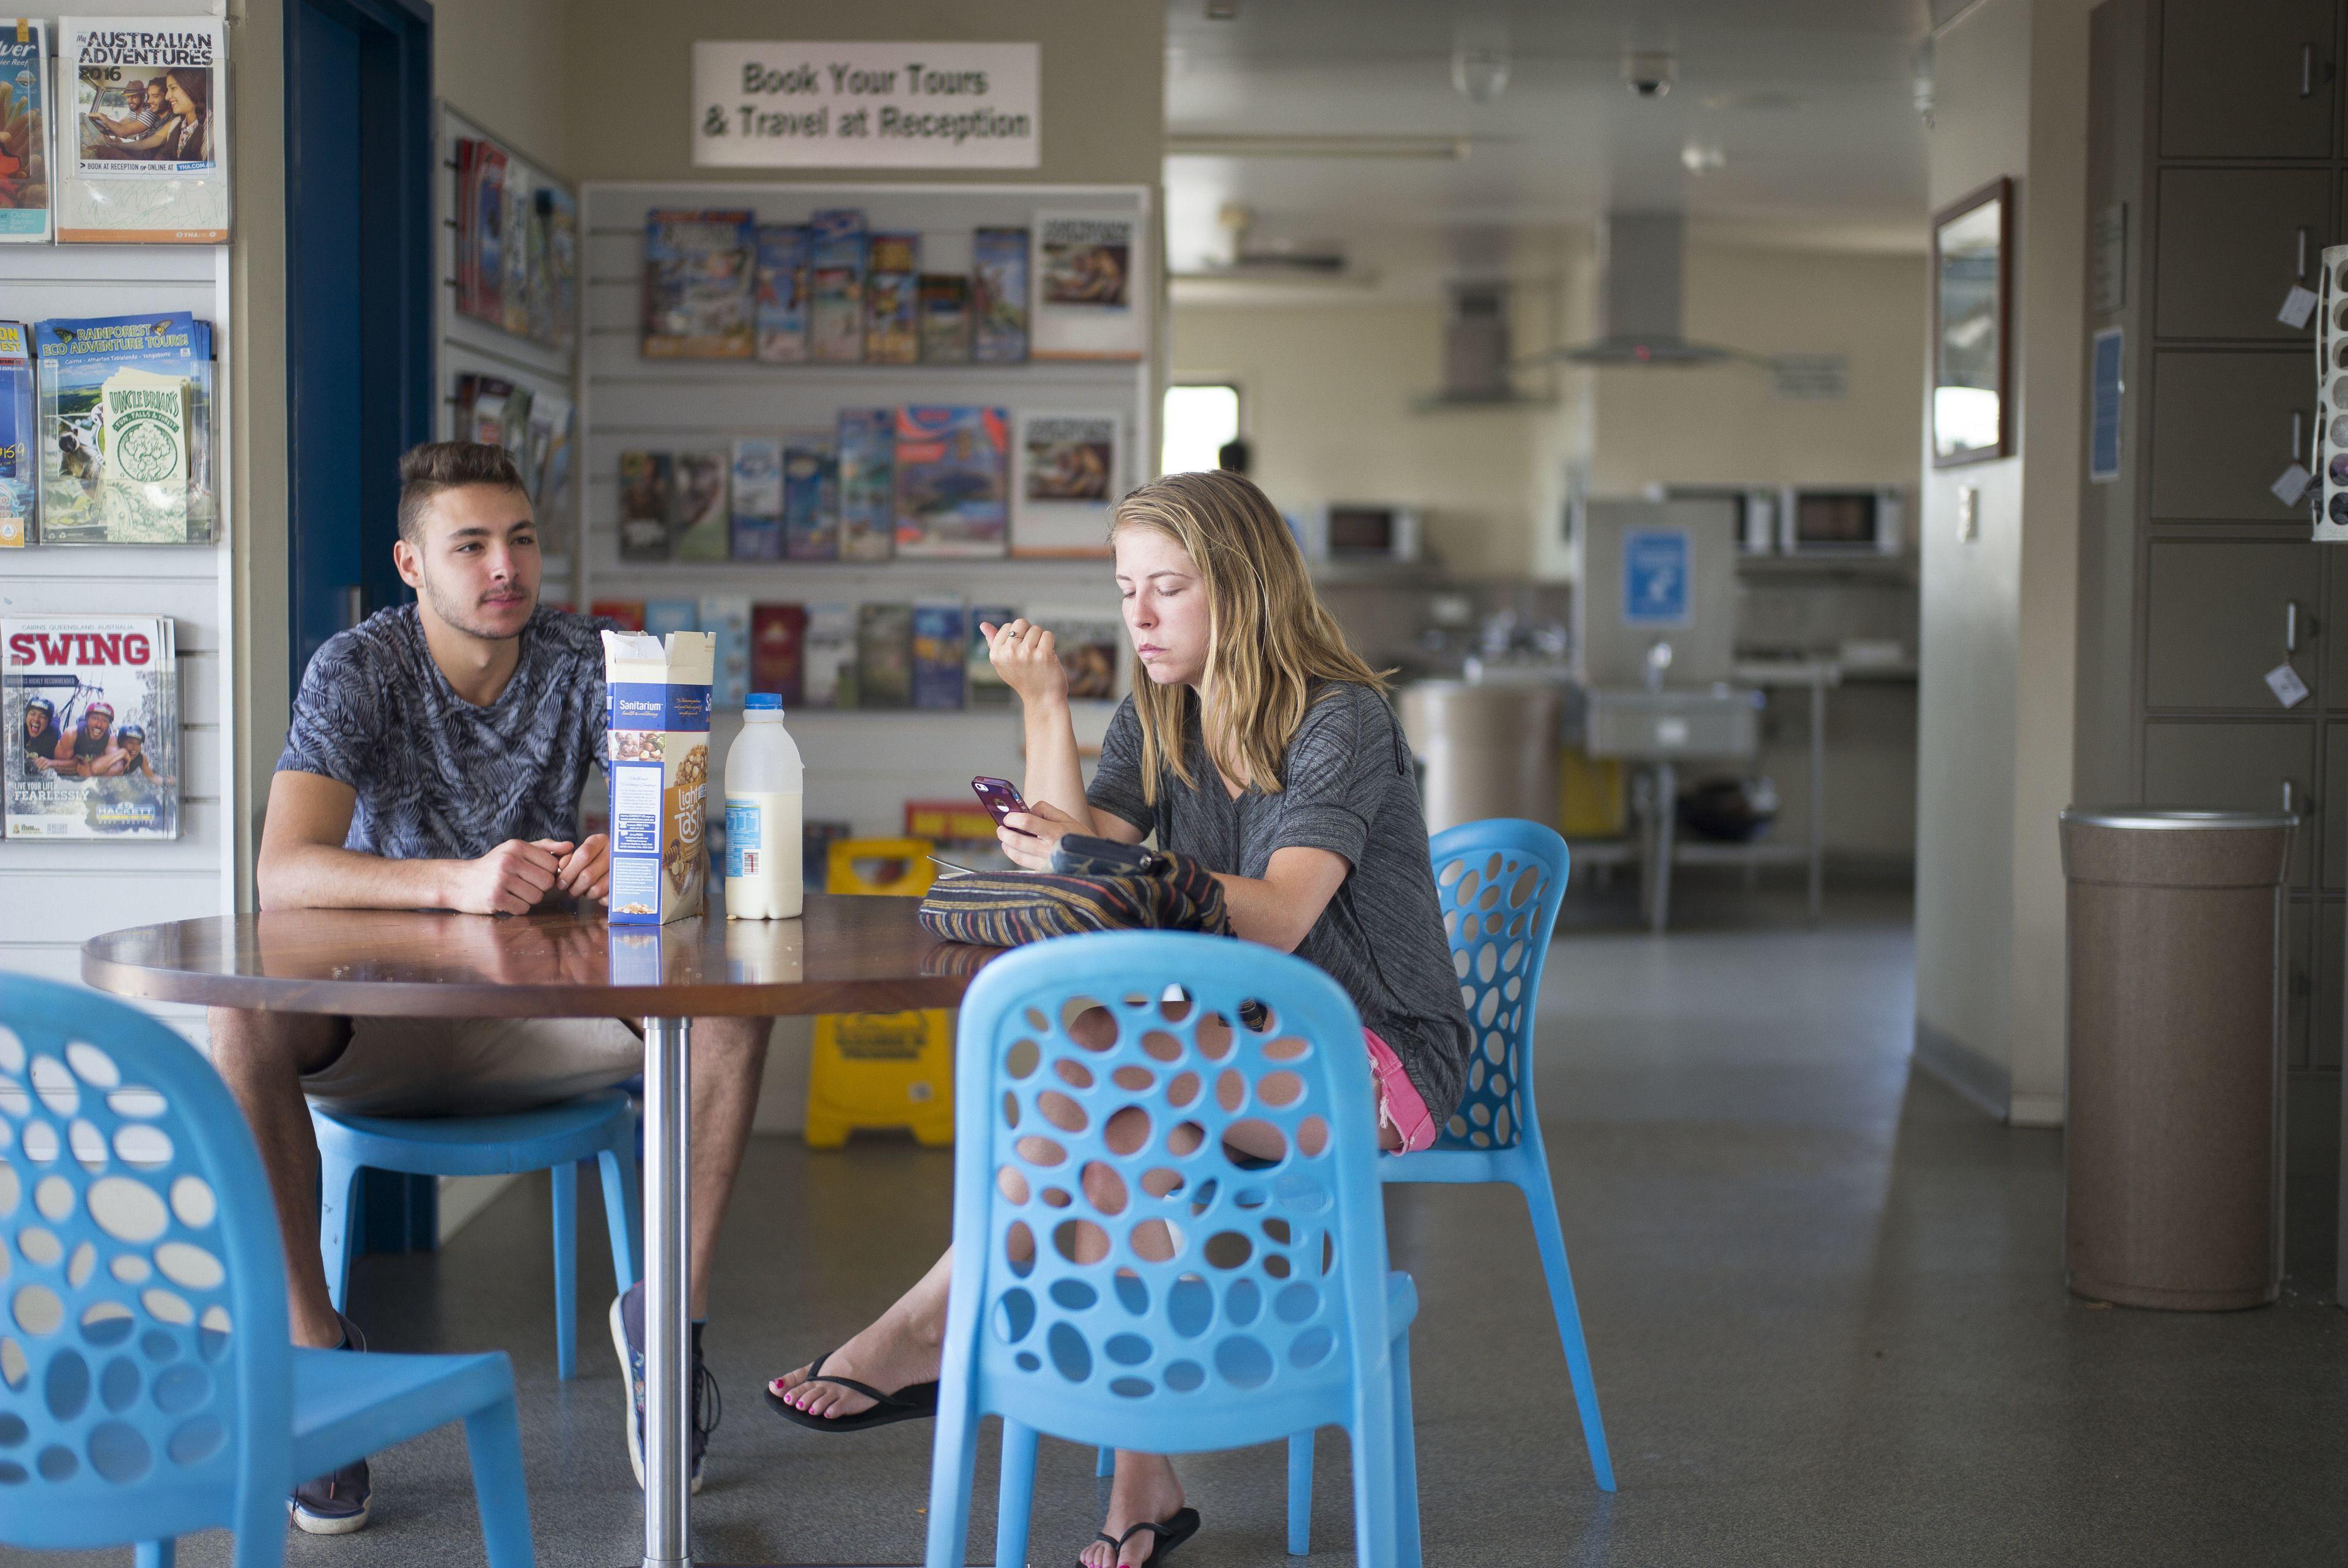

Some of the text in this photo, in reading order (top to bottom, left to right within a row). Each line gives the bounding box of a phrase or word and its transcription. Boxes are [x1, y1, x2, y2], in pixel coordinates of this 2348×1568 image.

[87, 31, 212, 49] AUSTRALIAN
[78, 48, 213, 65] ADVENTURES
[78, 66, 122, 81] 2016
[743, 62, 989, 95] Book Your Tours
[703, 105, 1031, 146] & Travel at Reception
[77, 323, 152, 341] RAINFOREST
[42, 343, 67, 356] ECO
[70, 338, 144, 354] ADVENTURE
[109, 390, 179, 418] UNCLE BRIAN'S
[9, 633, 151, 666] SWING
[619, 699, 661, 711] Sanitarium
[15, 781, 53, 790] LIVE YOUR LIFE
[14, 790, 90, 801] FEARLESSLY
[679, 785, 698, 811] Light
[98, 806, 152, 815] HACKETT
[674, 803, 704, 844] Tasty
